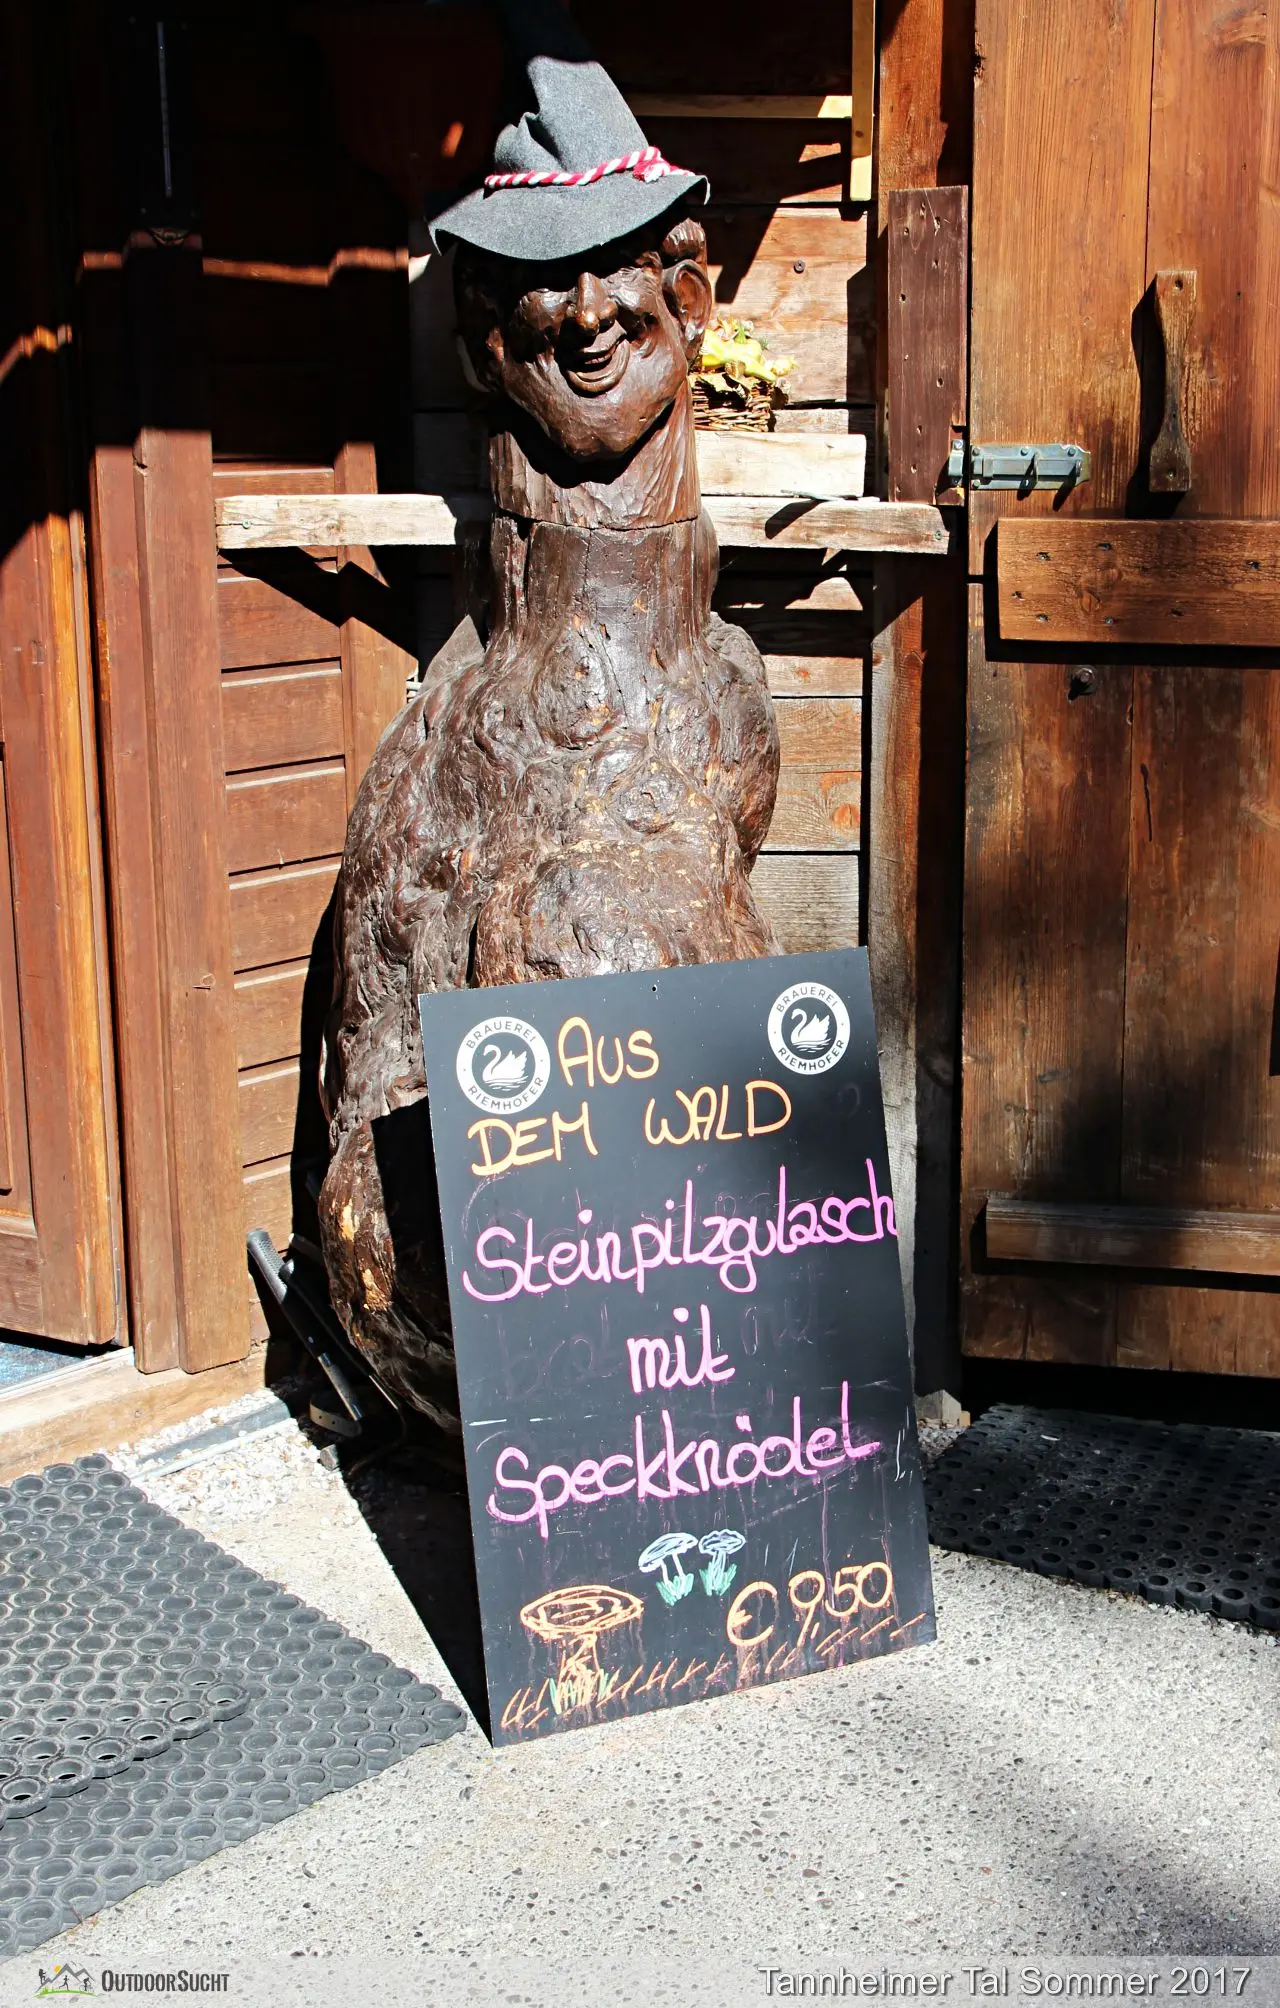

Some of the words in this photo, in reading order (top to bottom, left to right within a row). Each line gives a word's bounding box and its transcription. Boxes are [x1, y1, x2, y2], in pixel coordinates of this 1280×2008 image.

[776, 986, 838, 1013] BRAUEREI
[465, 1020, 537, 1049] BRAUEREI
[778, 1039, 845, 1071] RIEMHOFER
[468, 1077, 544, 1111] RIEMHOFER
[467, 1101, 599, 1177] DEM
[644, 1080, 792, 1146] WALD
[462, 1158, 899, 1302] Steinpilzgulasch
[627, 1304, 736, 1393] mit
[726, 1581, 778, 1647] €
